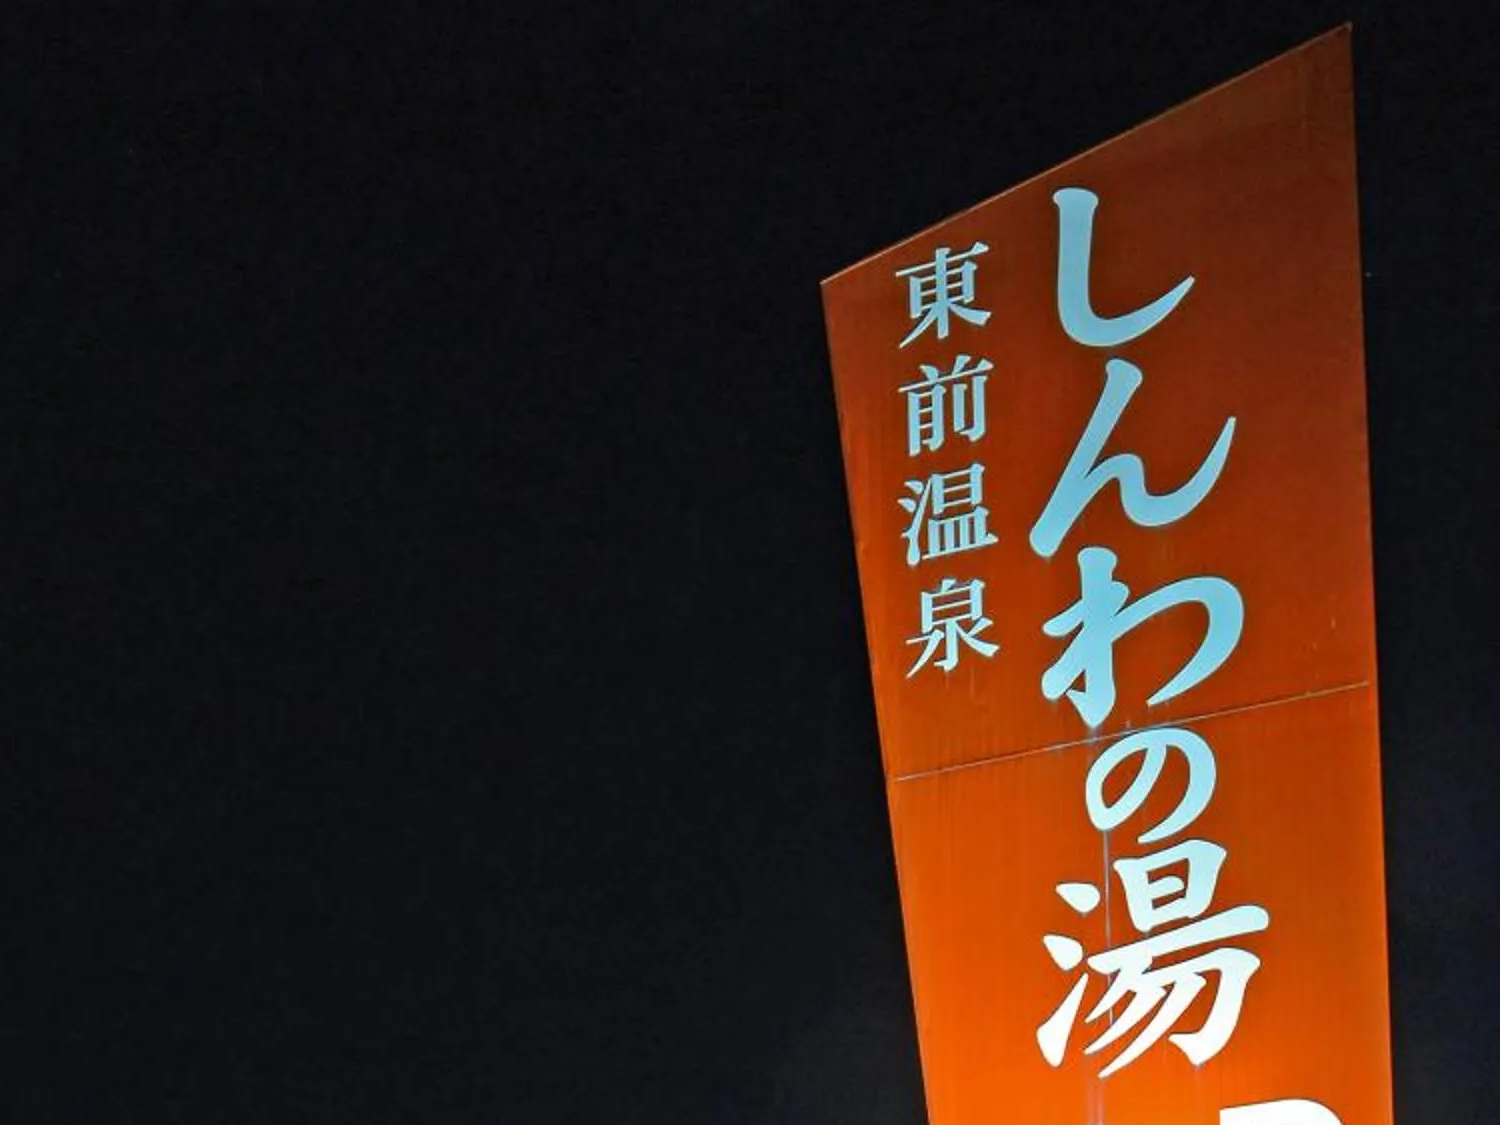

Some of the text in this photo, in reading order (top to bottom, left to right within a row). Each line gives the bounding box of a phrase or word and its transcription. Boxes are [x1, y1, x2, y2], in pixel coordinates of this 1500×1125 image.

[896, 241, 1001, 679] 東前温泉
[1030, 187, 1271, 1078] しんわの湯
